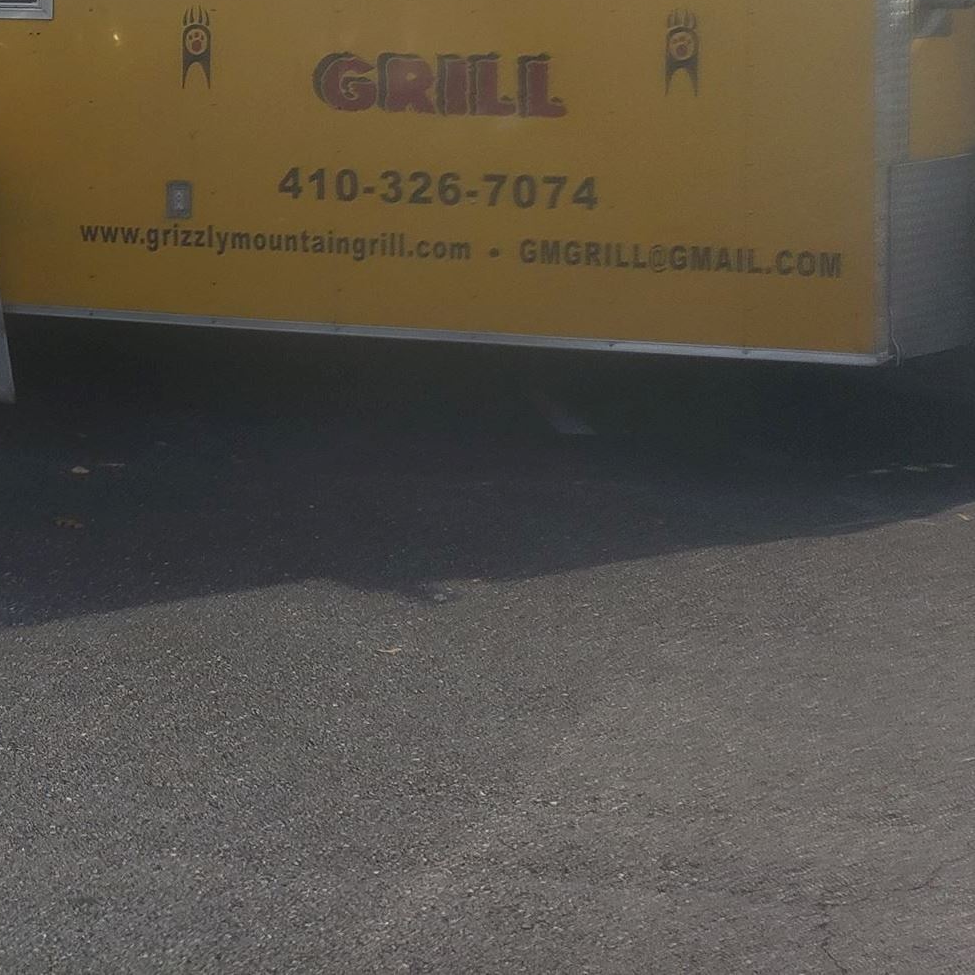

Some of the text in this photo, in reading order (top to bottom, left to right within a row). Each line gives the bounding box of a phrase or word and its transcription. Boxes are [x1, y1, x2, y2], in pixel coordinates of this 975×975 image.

[311, 52, 569, 118] GRILL
[278, 167, 599, 210] 410-326-7074
[80, 225, 842, 278] www.grizzlymountaingrill.com GMGRILL@GMAIL.COM
